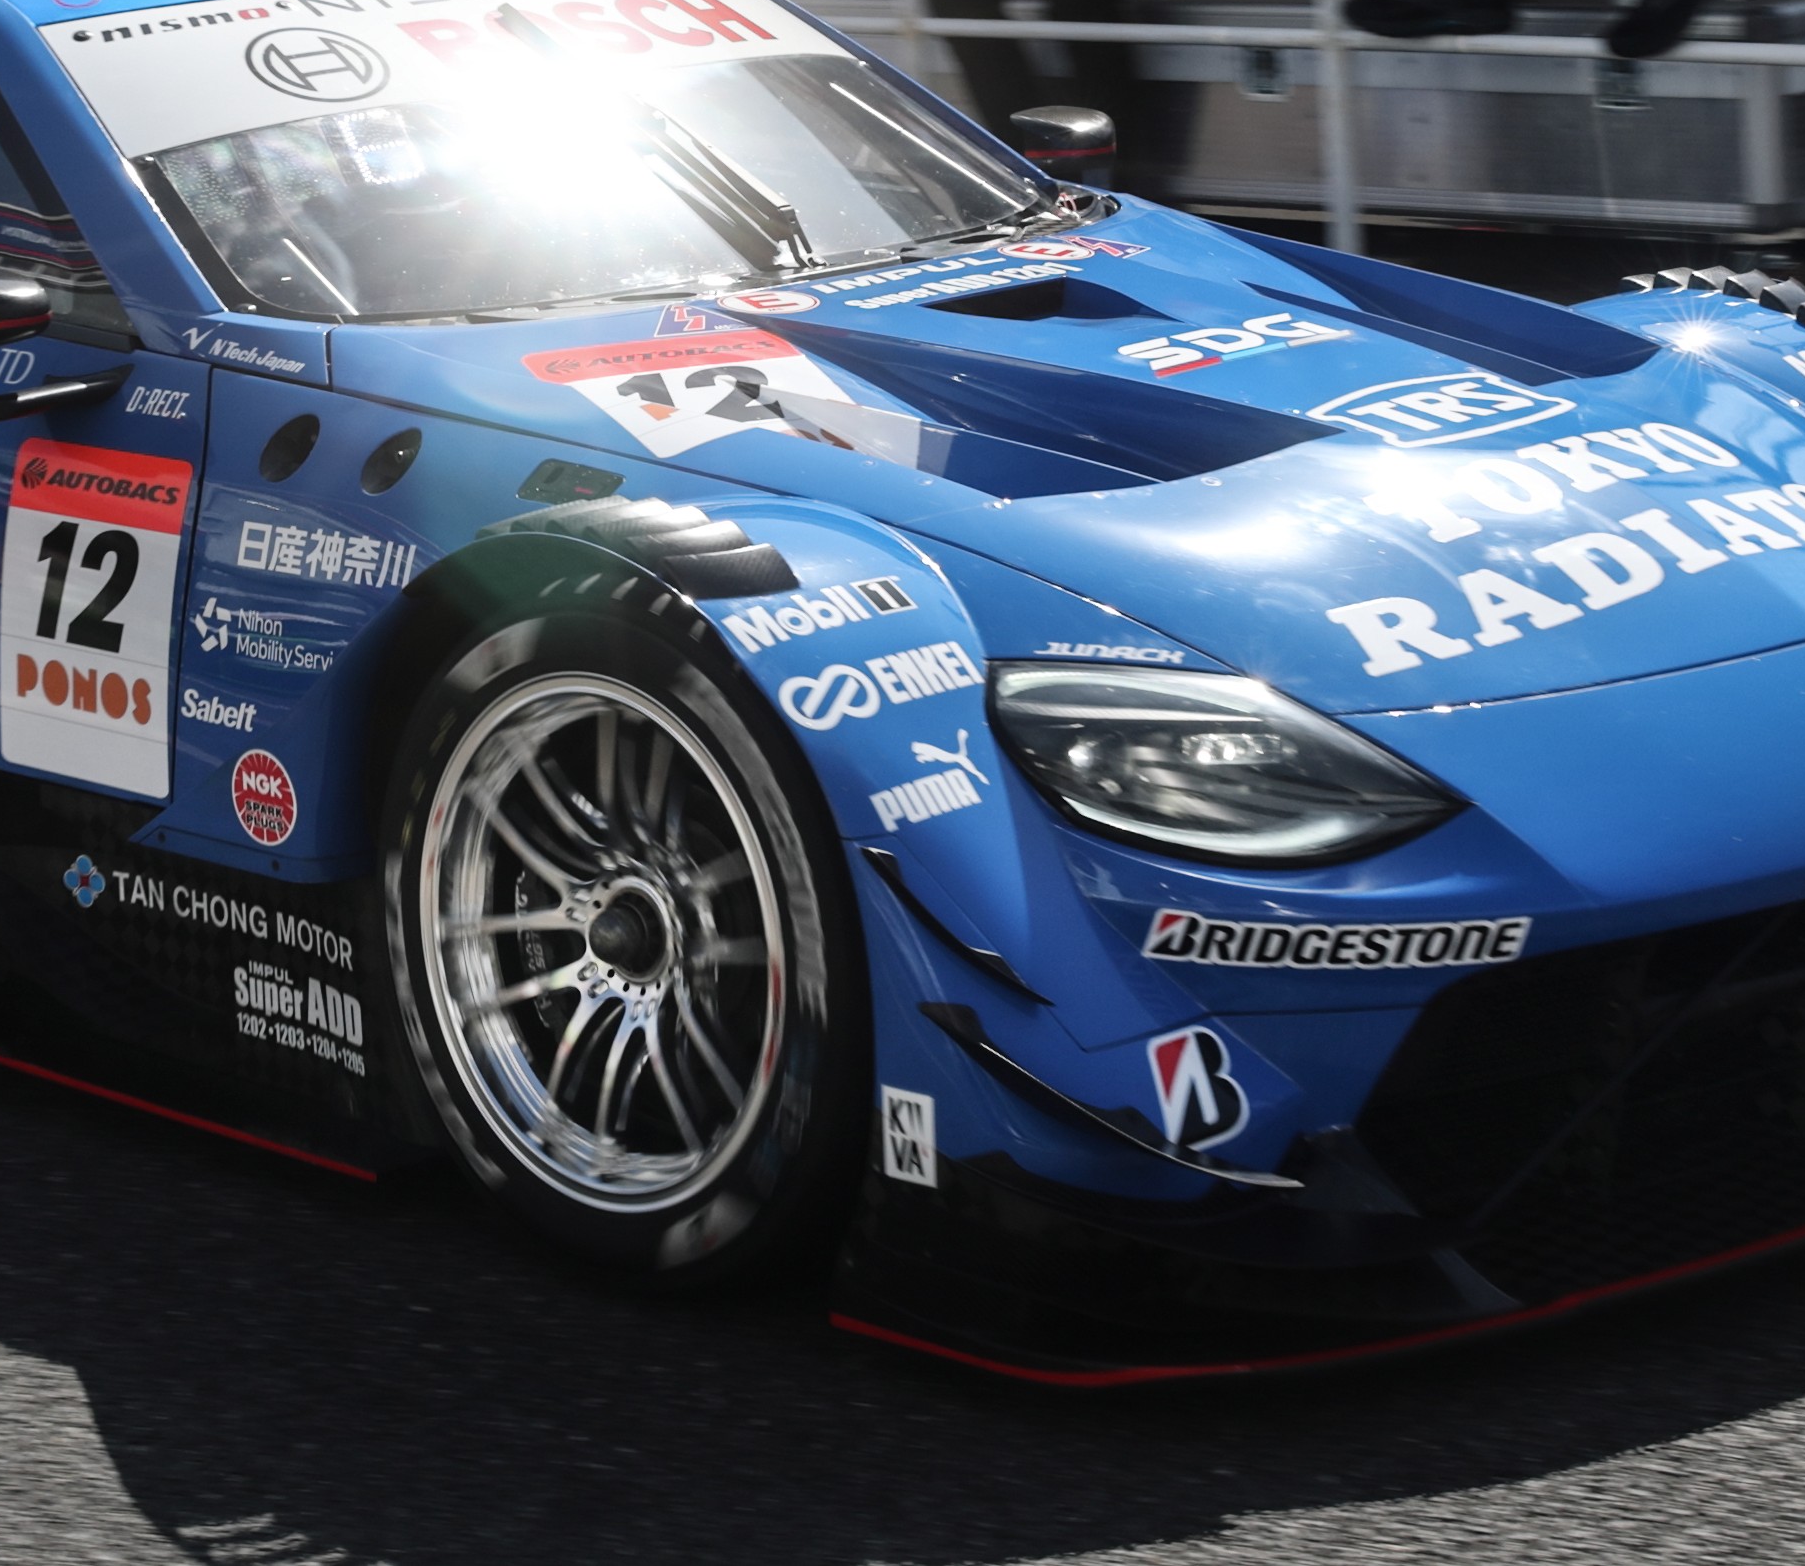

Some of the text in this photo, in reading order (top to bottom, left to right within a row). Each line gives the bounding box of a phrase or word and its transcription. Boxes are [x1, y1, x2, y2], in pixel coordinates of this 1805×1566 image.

[810, 255, 1007, 295] IMPUL
[1117, 312, 1344, 372] SDG
[616, 365, 785, 423] 12
[1362, 376, 1522, 433] TRS
[47, 467, 181, 507] AUTOBACS
[1372, 420, 1741, 544] TOKYO
[237, 521, 417, 589] 日産神奈川
[36, 521, 141, 654] 12
[237, 608, 283, 636] Nihon
[721, 585, 872, 654] Mobil
[236, 633, 294, 669] Mobility
[864, 640, 986, 705] ENKEI
[1035, 639, 1186, 665] JUNACK
[17, 653, 152, 726] PONOS
[181, 688, 257, 733] Sabelt
[242, 770, 283, 800] NGK
[244, 799, 283, 819] SPARK
[869, 768, 983, 833] PUMA
[245, 813, 285, 833] PLUGS
[112, 870, 354, 972] TAN CHONG MOTOR
[1142, 908, 1532, 970] BRIDGESTONE
[248, 960, 295, 986] IMPUL
